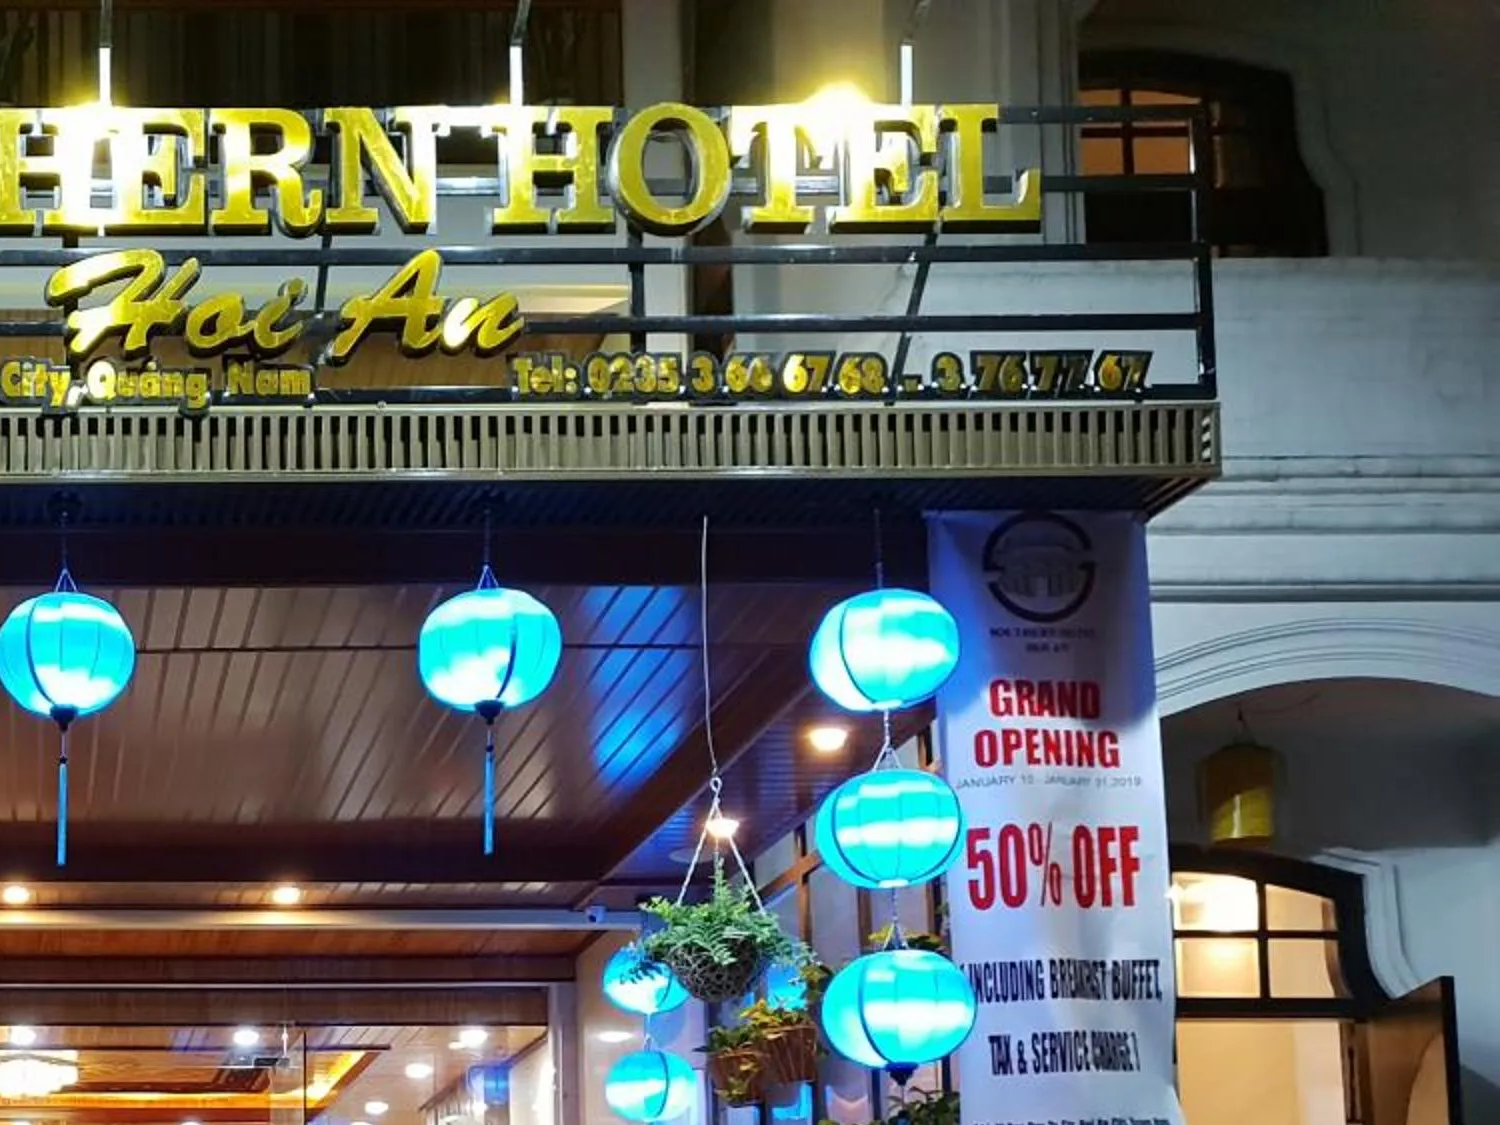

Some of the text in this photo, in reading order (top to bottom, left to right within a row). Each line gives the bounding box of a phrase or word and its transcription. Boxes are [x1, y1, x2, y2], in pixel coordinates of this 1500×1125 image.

[489, 100, 1044, 237] HOTEL
[45, 248, 525, 366] Hoi An
[226, 361, 312, 398] Nam
[512, 354, 578, 394] Tel:
[586, 354, 681, 394] 0235
[691, 355, 716, 393] 3
[724, 354, 774, 394] 66
[782, 353, 832, 394] 67
[837, 354, 884, 394] 68
[935, 354, 961, 392] 3
[974, 353, 1025, 392] 76
[989, 679, 1100, 720] GRAND
[974, 728, 1121, 768] OPENING
[956, 775, 1016, 789] JANUARY
[966, 821, 1141, 911] 50% OFF
[961, 960, 1045, 1004] INCLUDING
[988, 1034, 1014, 1076] TAX
[1017, 1039, 1029, 1075] &
[1031, 1030, 1091, 1075] SERVICE
